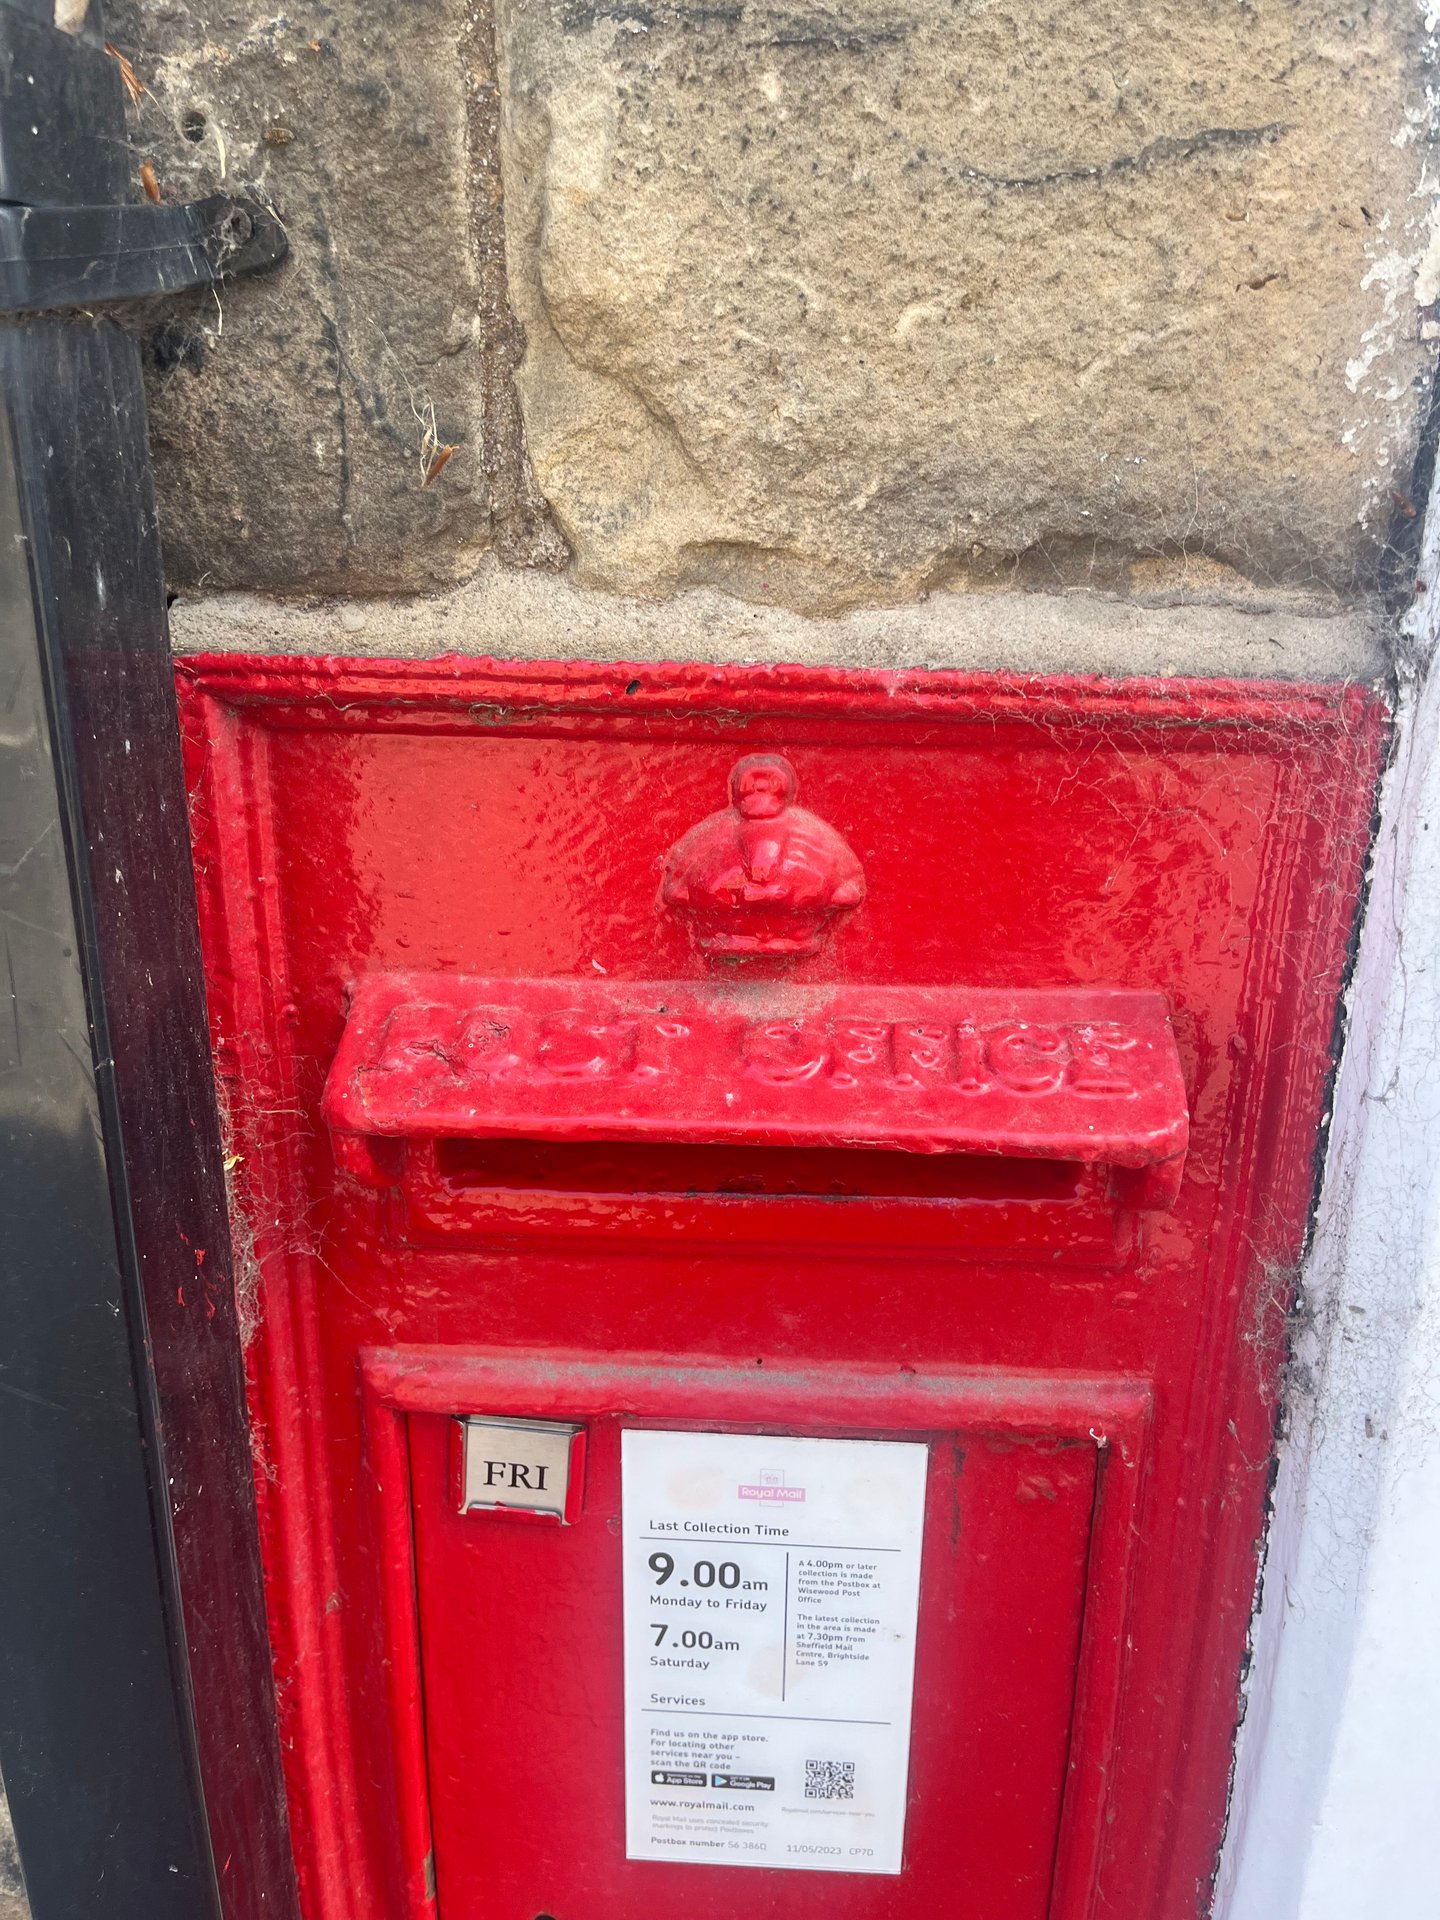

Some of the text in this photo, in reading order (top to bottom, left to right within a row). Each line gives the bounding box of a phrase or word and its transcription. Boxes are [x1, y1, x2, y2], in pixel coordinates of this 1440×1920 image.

[739, 1016, 1140, 1100] OFFICE
[483, 1460, 549, 1491] FRI
[741, 1487, 802, 1499] Royal Mail
[649, 1519, 790, 1537] Last Collection Time
[807, 1560, 843, 1569] 4.00pm
[647, 1551, 769, 1592] 9.00am
[798, 1587, 840, 1596] Wisewood
[649, 1595, 767, 1612] Monday to Friday
[649, 1623, 740, 1651] 7.00am
[807, 1632, 843, 1642] 7.30pm
[796, 1642, 853, 1651] Sheffield Mail
[796, 1650, 870, 1661] Centre, Brightside
[649, 1656, 710, 1671] Saturday
[649, 1694, 706, 1706] Services
[650, 1729, 671, 1738] Find
[702, 1731, 718, 1740] the
[721, 1733, 739, 1742] app
[741, 1734, 769, 1742] store.
[650, 1739, 735, 1751] For locating other
[650, 1749, 688, 1758] services
[691, 1751, 713, 1759] near
[716, 1753, 733, 1761] you
[674, 1760, 690, 1769] the
[693, 1761, 706, 1770] QR
[709, 1761, 731, 1770] code
[666, 1776, 703, 1785] App Store
[729, 1779, 772, 1790] Google Play
[650, 1799, 755, 1812] www.royalmail.com
[651, 1814, 671, 1822] Royal
[741, 1820, 769, 1828] security
[652, 1823, 683, 1831] markings
[694, 1825, 718, 1833] protect
[650, 1836, 686, 1845] Postbox
[689, 1838, 725, 1848] number
[727, 1840, 740, 1849] S6
[786, 1844, 874, 1856] 11/05/2023 CP7D
